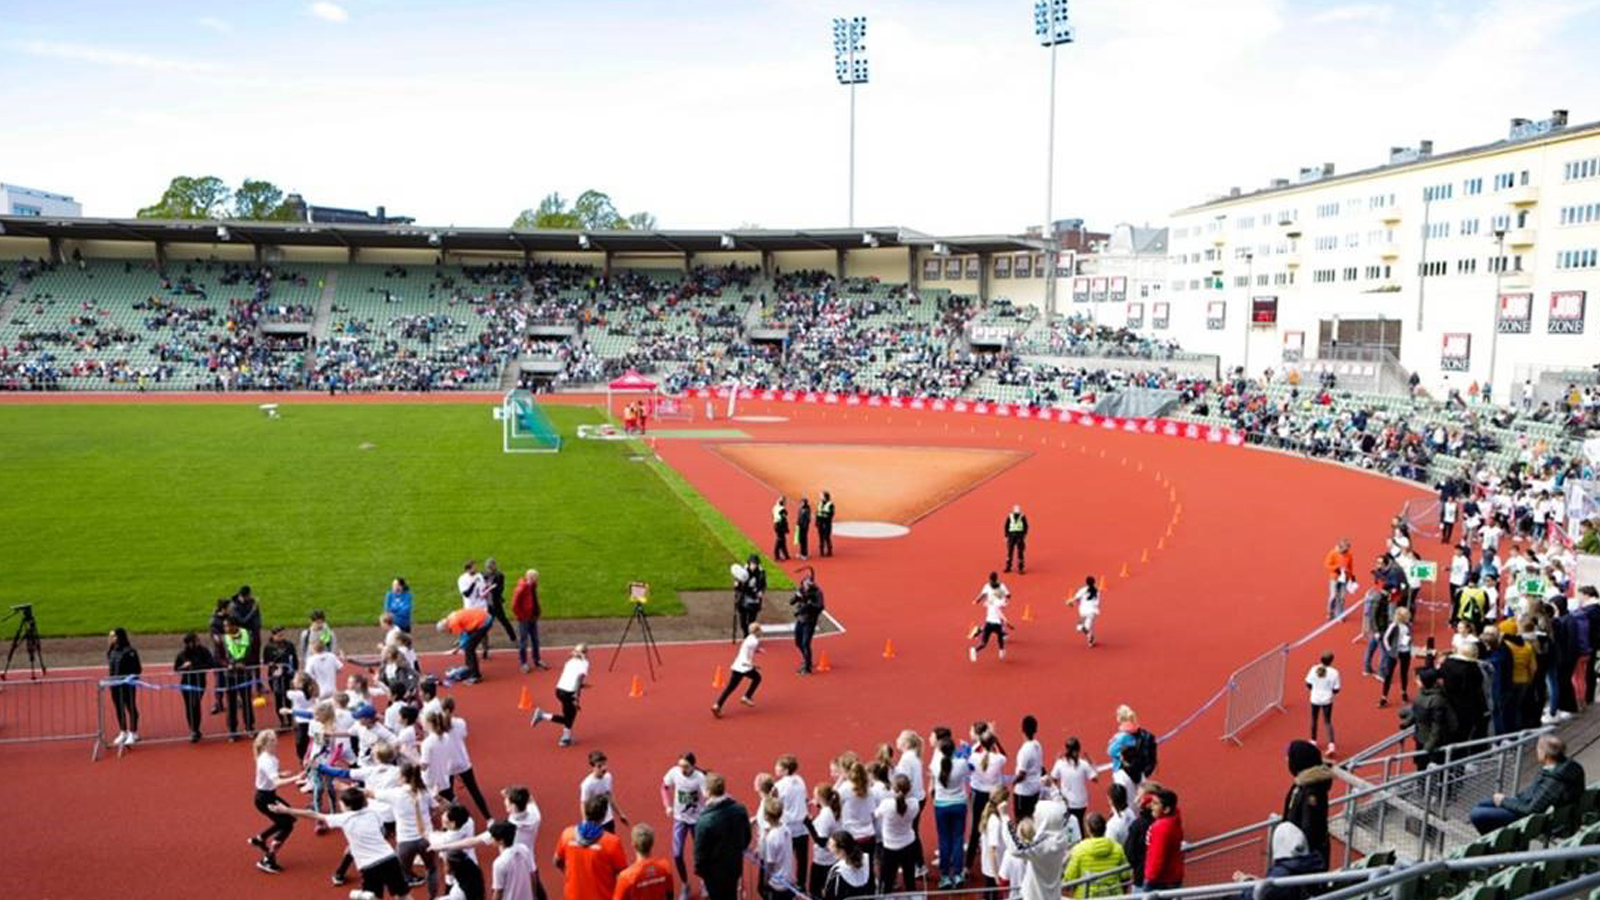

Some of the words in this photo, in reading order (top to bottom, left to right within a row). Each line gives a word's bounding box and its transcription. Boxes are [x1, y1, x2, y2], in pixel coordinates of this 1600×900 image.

[1498, 320, 1530, 332] ZONE
[1548, 320, 1583, 332] ZONE
[1441, 358, 1470, 369] ZONE
